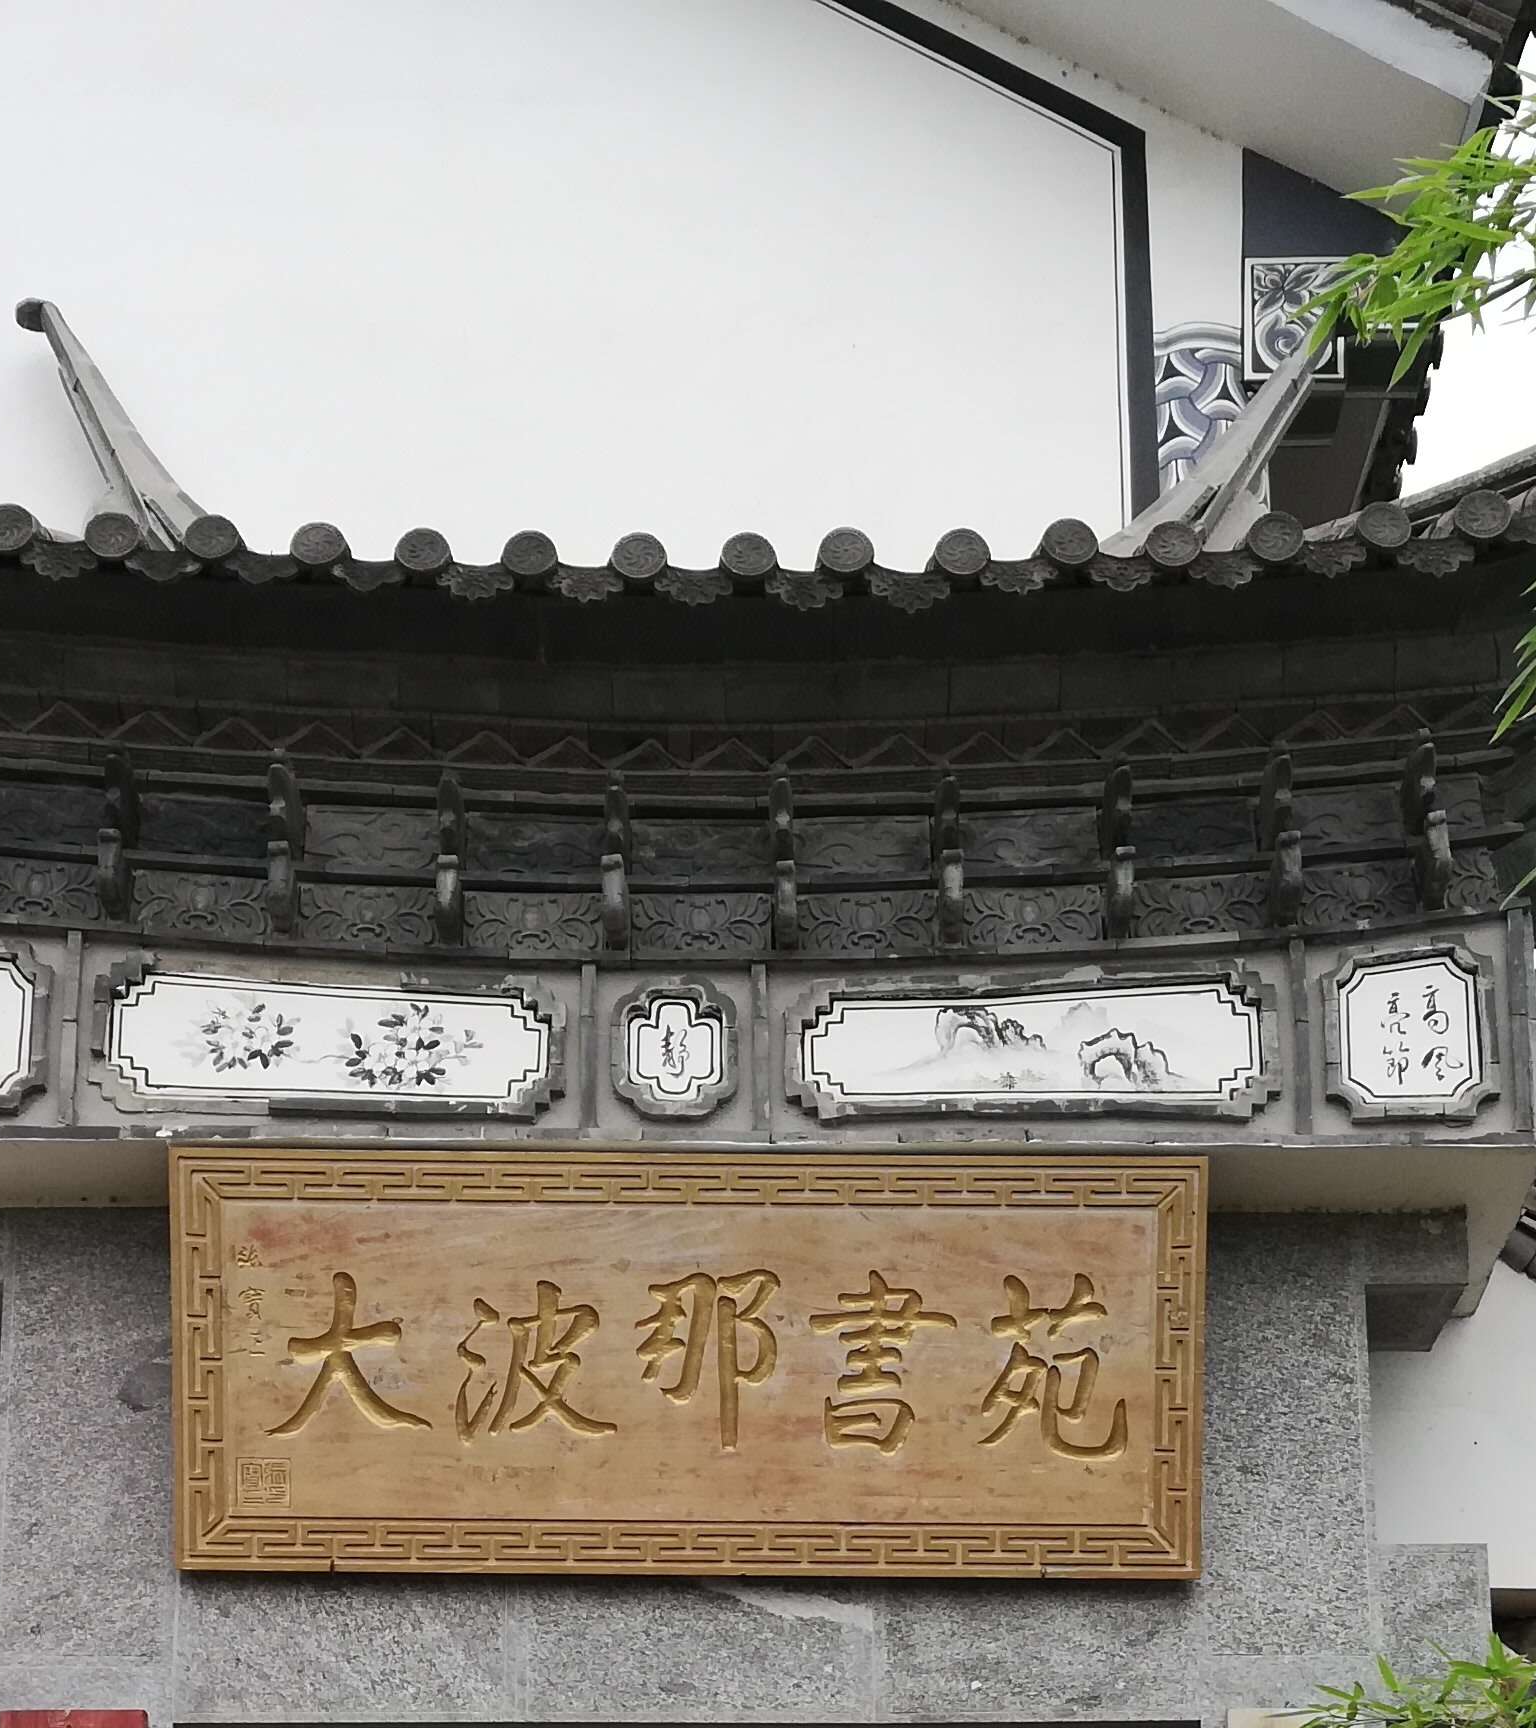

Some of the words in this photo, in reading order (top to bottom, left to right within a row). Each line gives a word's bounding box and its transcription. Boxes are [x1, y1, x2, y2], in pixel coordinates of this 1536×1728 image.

[265, 1267, 1128, 1461] 大波那書苑
